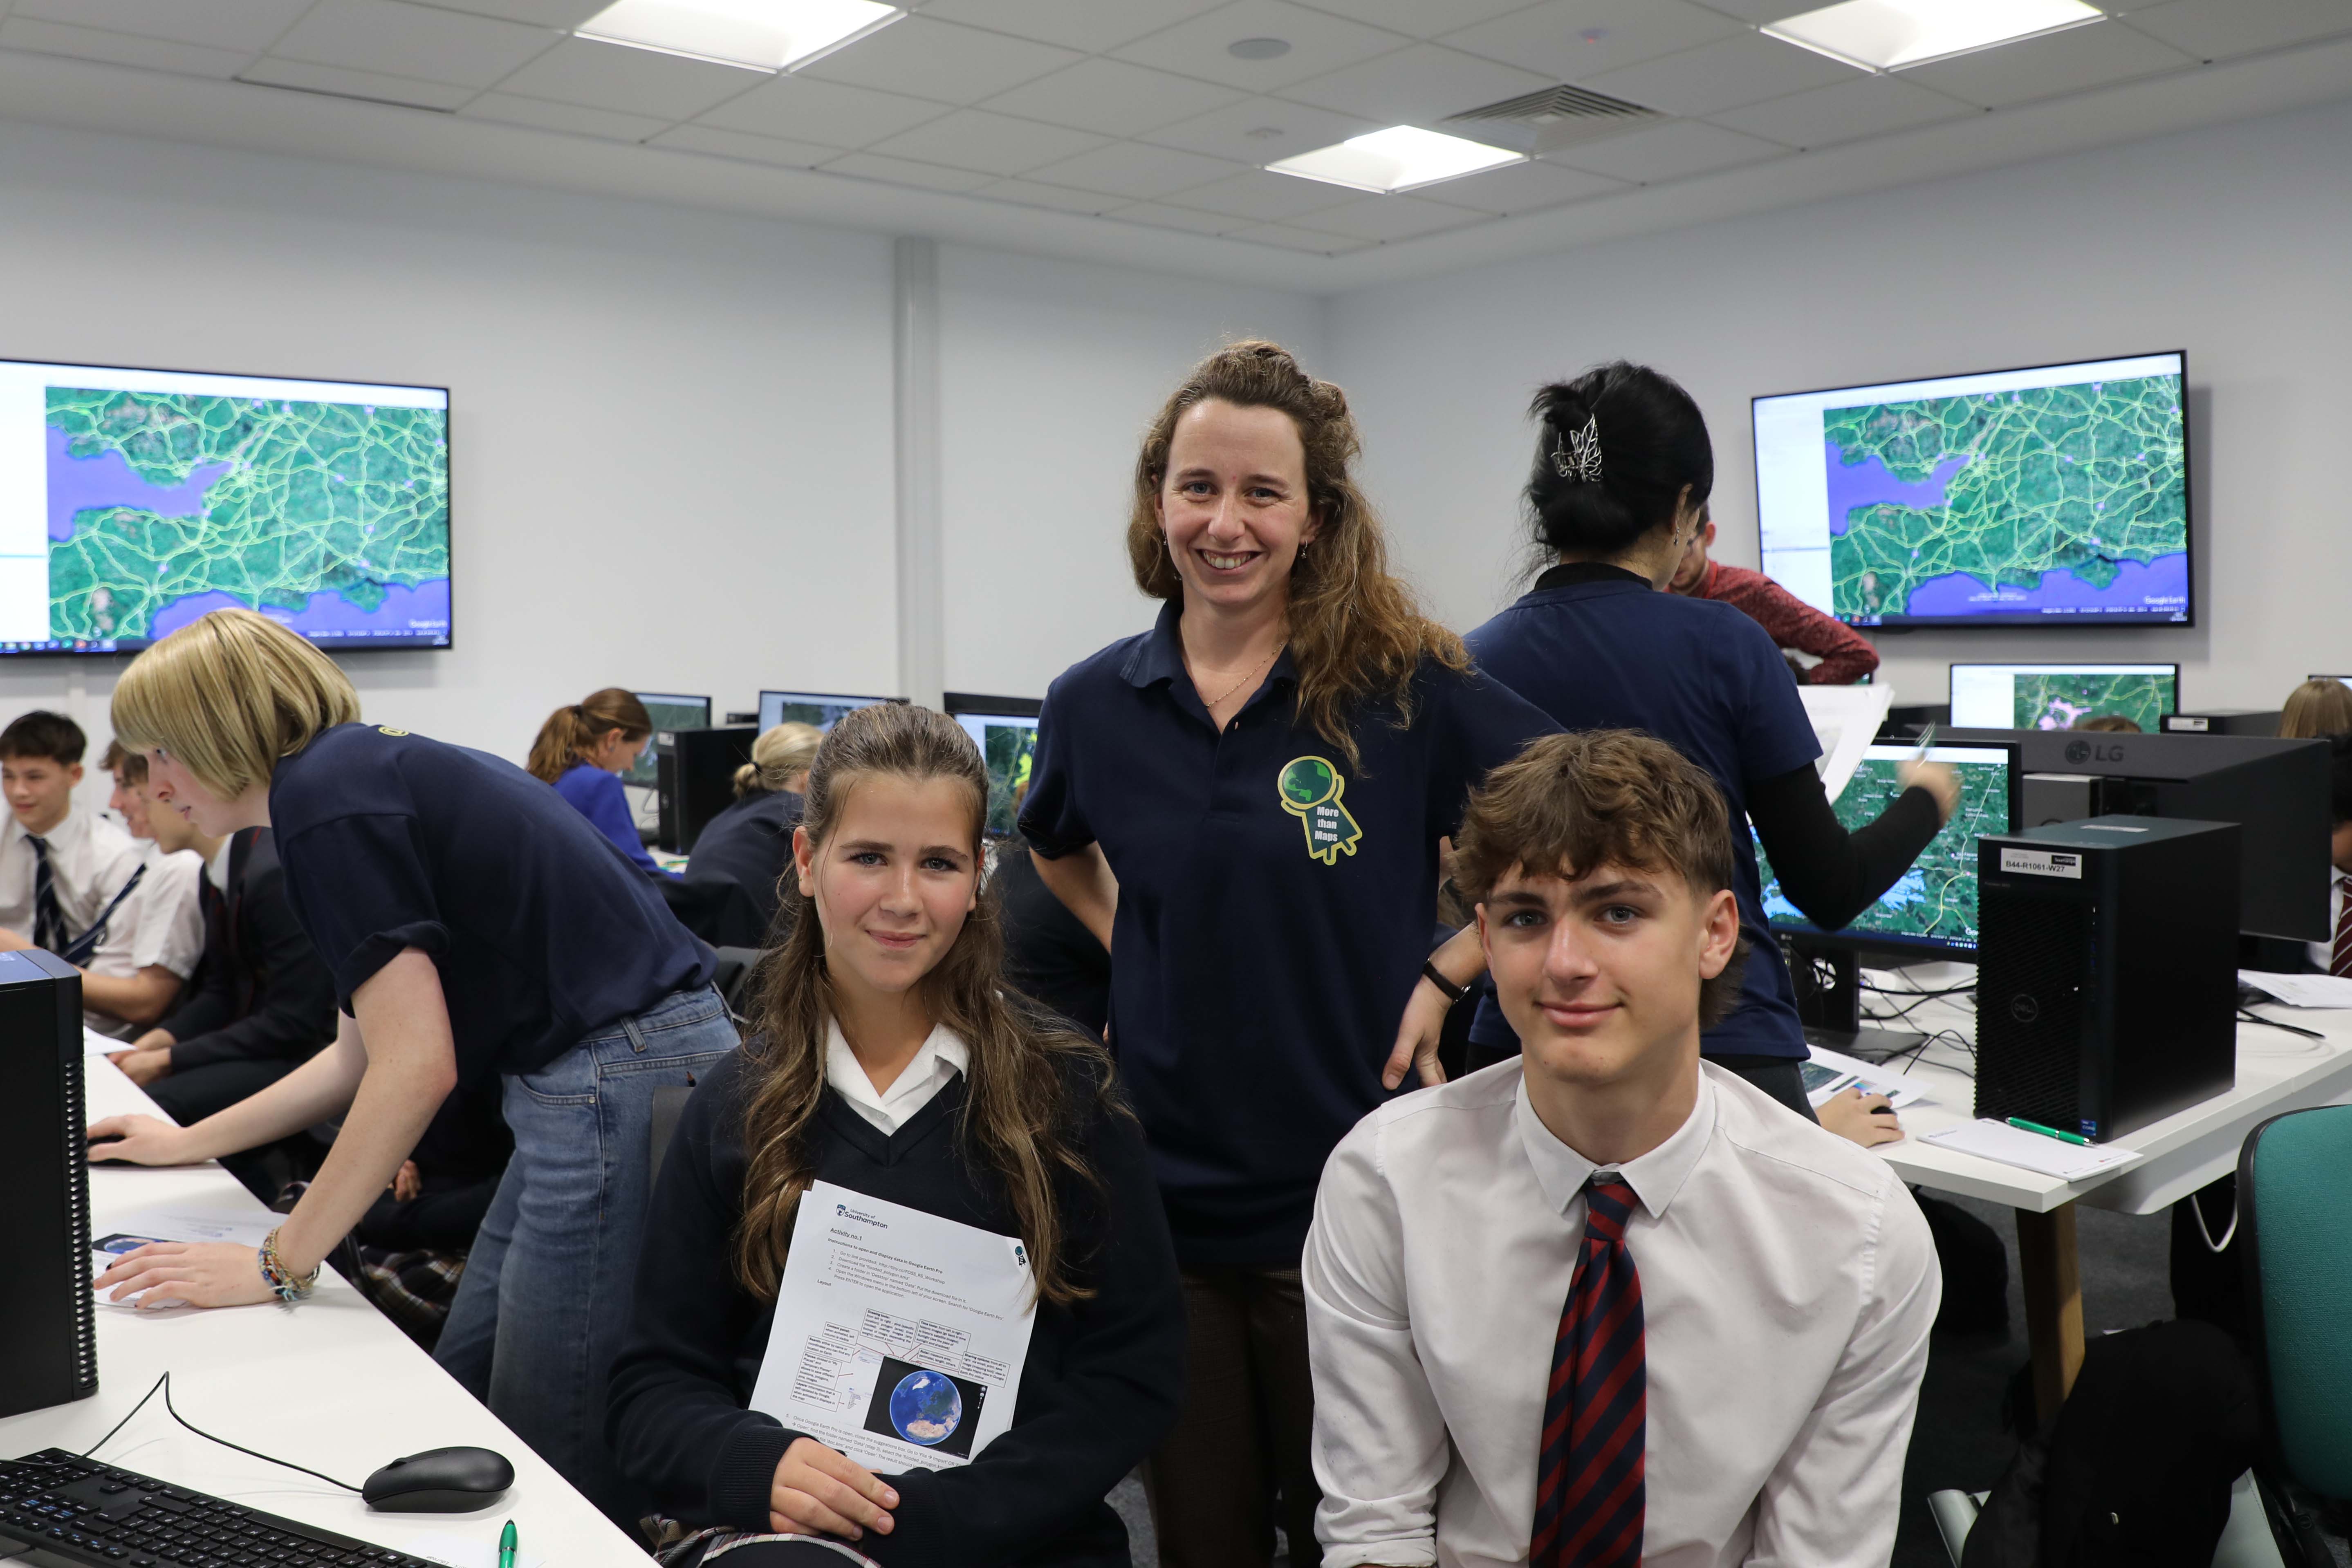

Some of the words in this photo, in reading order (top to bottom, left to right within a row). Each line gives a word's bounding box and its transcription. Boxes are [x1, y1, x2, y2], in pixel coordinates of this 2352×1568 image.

[2095, 745, 2124, 762] LG
[1317, 806, 1339, 817] More
[1317, 819, 1337, 829] than
[1315, 830, 1338, 842] Maps
[2006, 860, 2065, 872] B44-R1061-W27
[850, 1208, 870, 1218] University
[844, 1211, 888, 1229] Southampton
[830, 1228, 850, 1238] Activity
[827, 1237, 852, 1248] Instructions
[838, 1257, 859, 1266] Download
[859, 1257, 877, 1265] provided:
[854, 1273, 872, 1282] Windows
[881, 1289, 904, 1298] application.
[931, 1290, 951, 1299] download
[873, 1440, 897, 1449] suggestions
